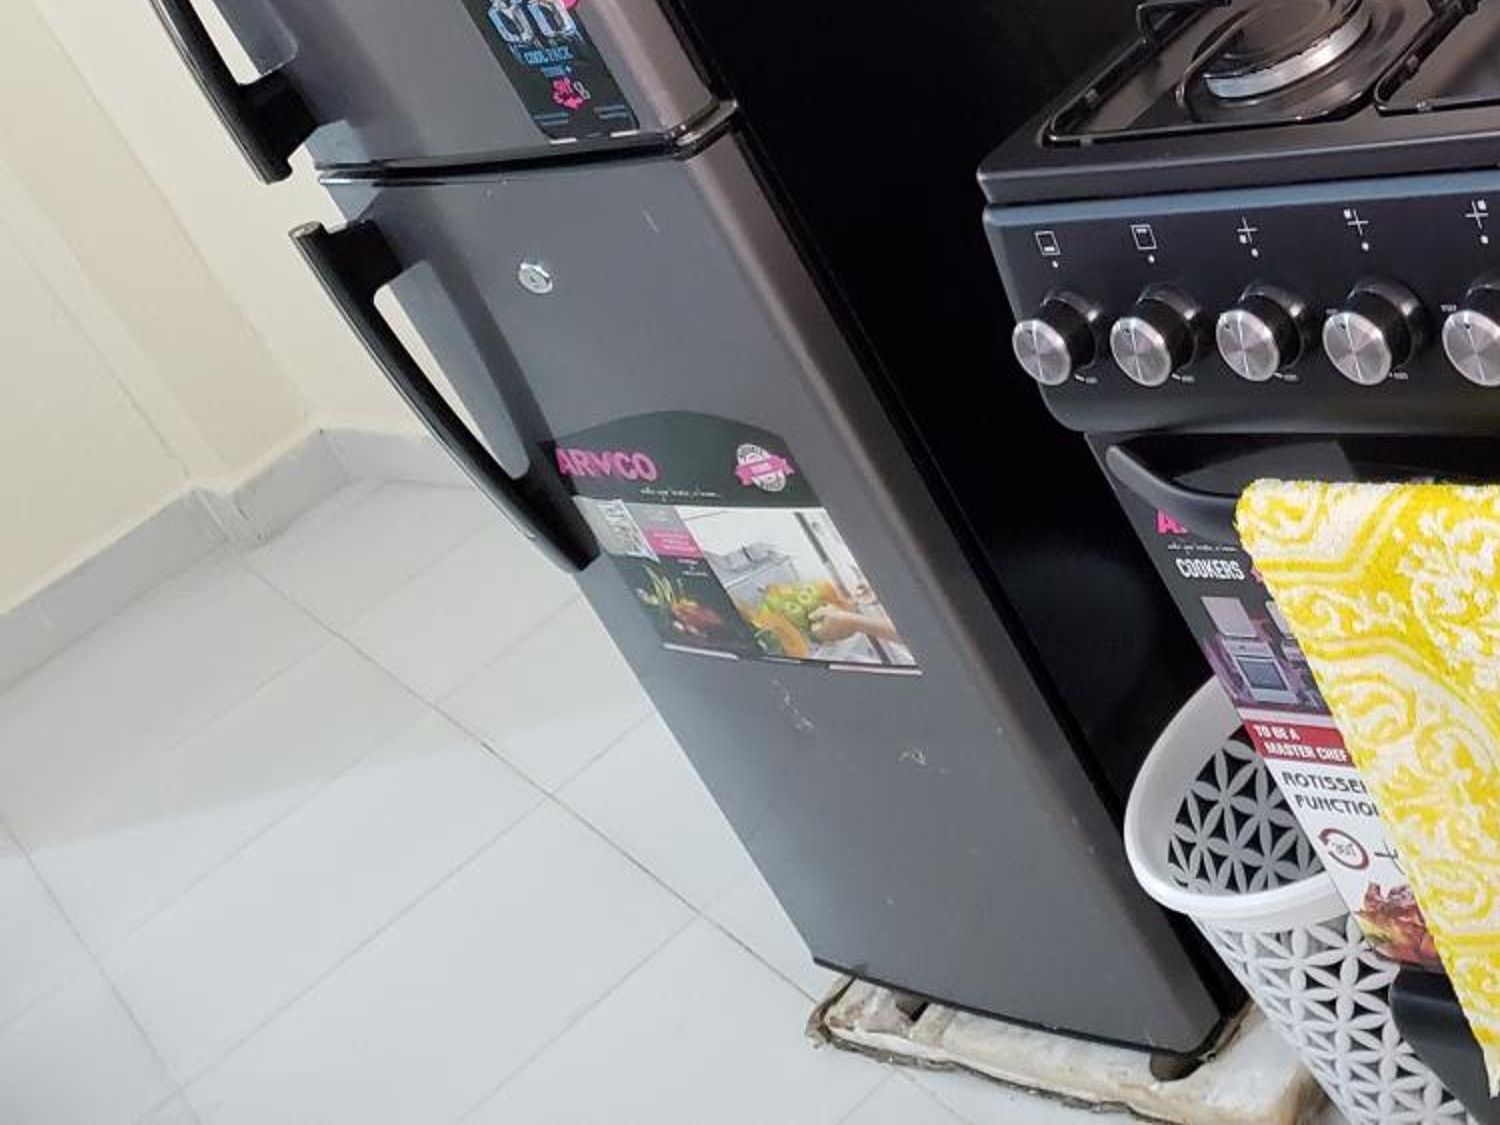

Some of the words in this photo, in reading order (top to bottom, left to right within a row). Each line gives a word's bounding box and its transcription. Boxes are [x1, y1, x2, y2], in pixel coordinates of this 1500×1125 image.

[1175, 558, 1245, 581] COOKERS
[1289, 728, 1300, 741] A
[1264, 742, 1317, 759] MASTER
